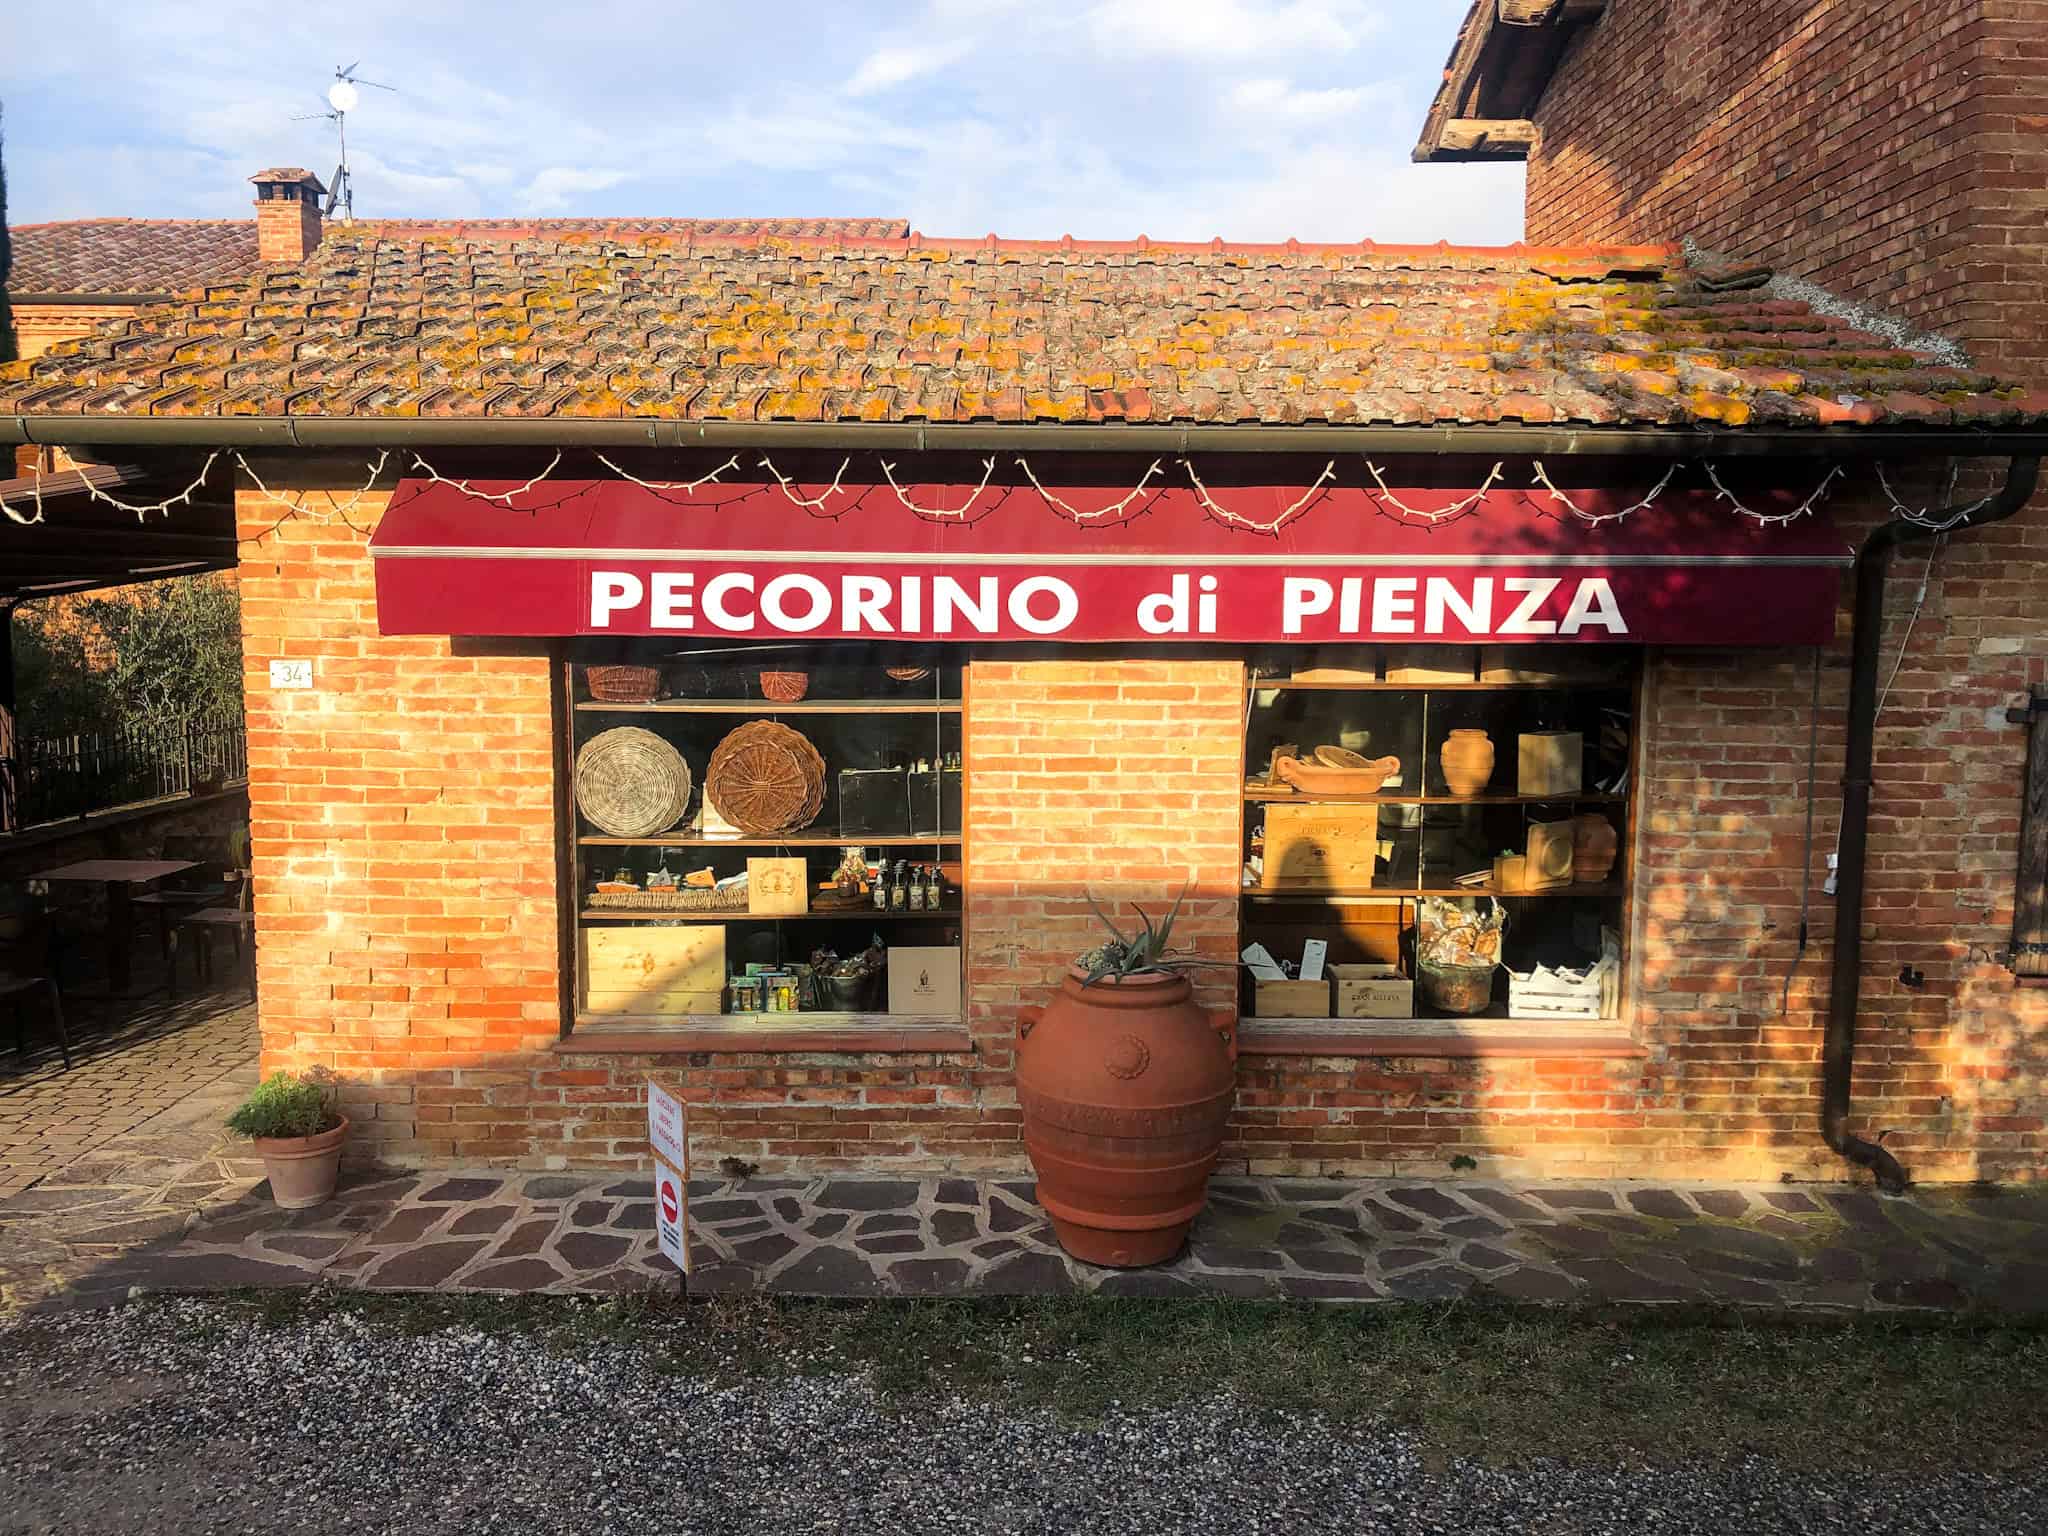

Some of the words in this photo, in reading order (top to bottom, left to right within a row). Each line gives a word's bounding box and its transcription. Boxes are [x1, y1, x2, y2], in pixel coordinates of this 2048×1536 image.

[590, 571, 1079, 634] PECORINO
[1136, 574, 1218, 633] di
[1282, 577, 1630, 634] PIENZA
[281, 665, 302, 682] 34
